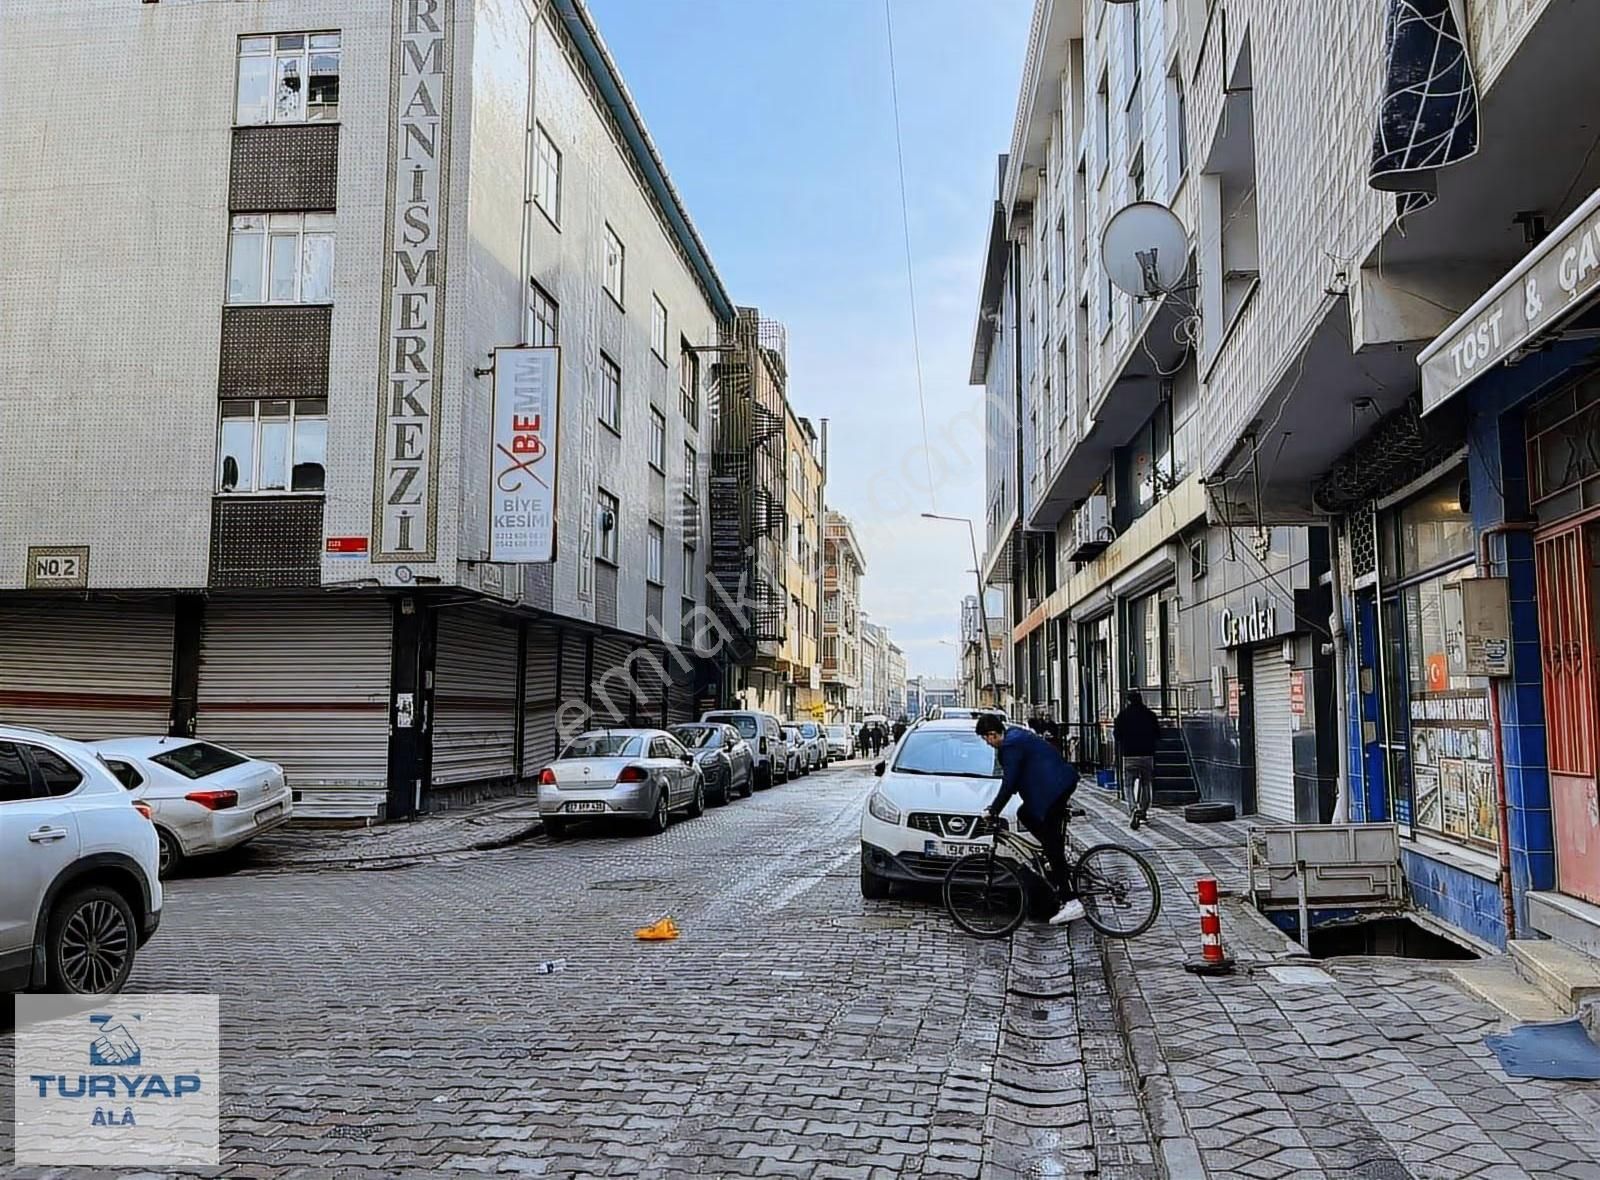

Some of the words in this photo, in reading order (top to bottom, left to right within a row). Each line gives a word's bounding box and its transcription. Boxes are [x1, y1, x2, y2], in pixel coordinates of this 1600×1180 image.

[1451, 308, 1502, 377] TOST
[1525, 278, 1543, 321] &
[503, 496, 542, 512] BİYE
